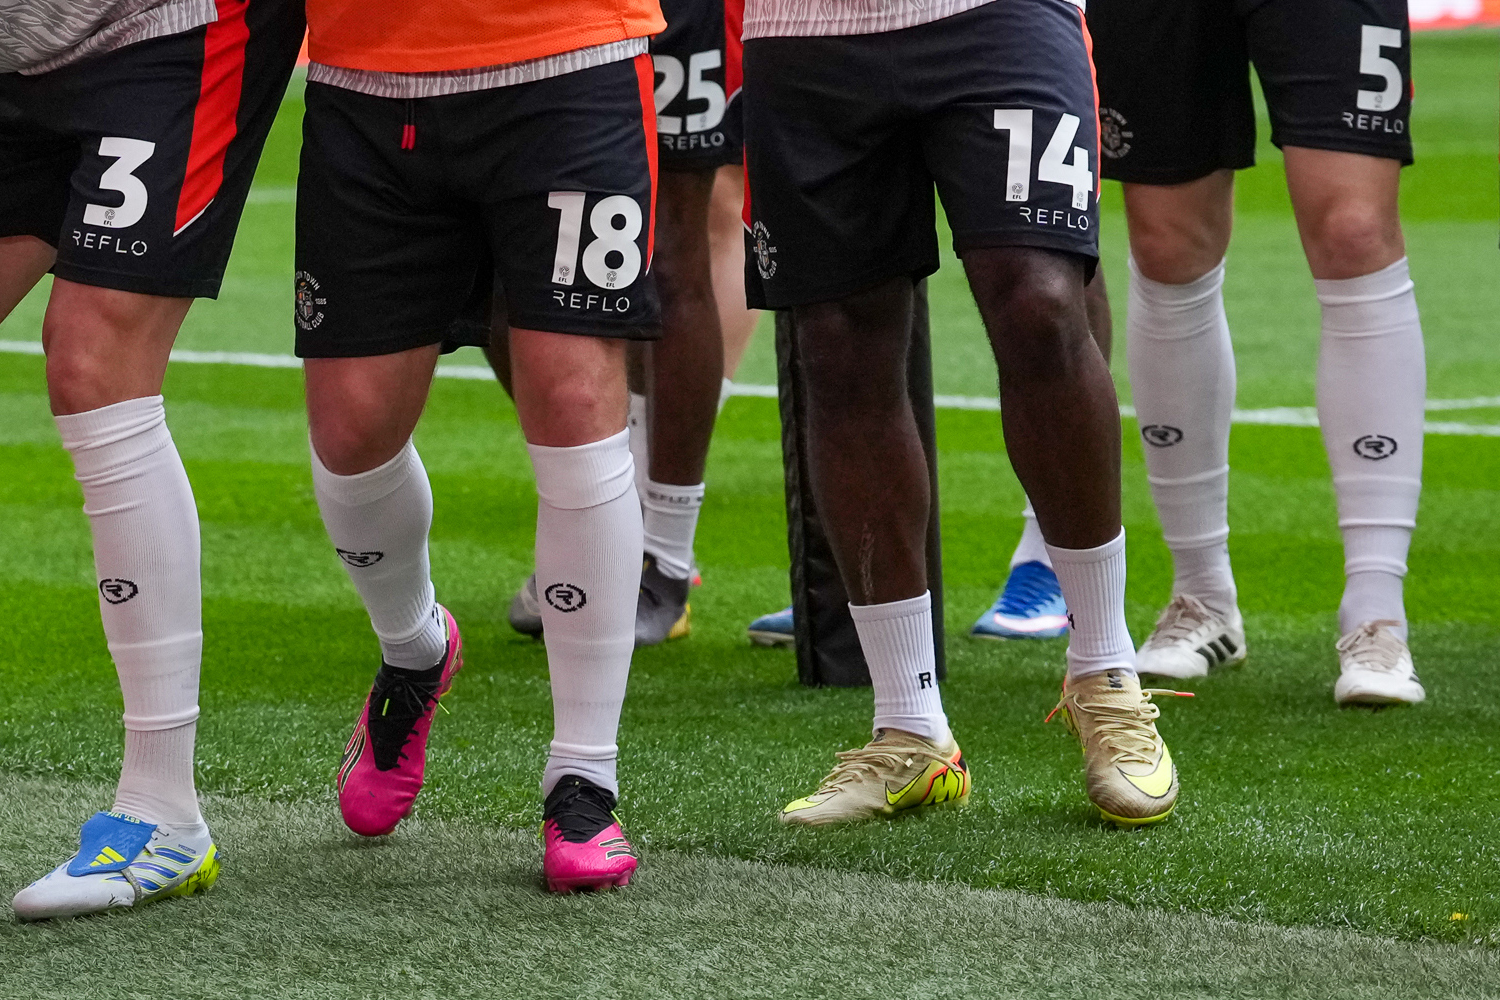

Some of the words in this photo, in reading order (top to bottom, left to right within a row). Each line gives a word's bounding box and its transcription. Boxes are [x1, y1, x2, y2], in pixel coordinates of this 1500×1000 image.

[1356, 24, 1403, 112] 5
[651, 48, 727, 136] 25
[1341, 111, 1404, 135] REFLO
[663, 131, 725, 151] REFLO
[993, 108, 1094, 211] 14
[82, 136, 156, 229] 3
[103, 219, 113, 227] EFL
[1019, 206, 1089, 231] REFLO
[72, 230, 148, 257] REFLO
[547, 190, 643, 290] 18
[552, 290, 631, 313] REFLO
[311, 311, 325, 328] CLUB
[918, 671, 932, 689] R
